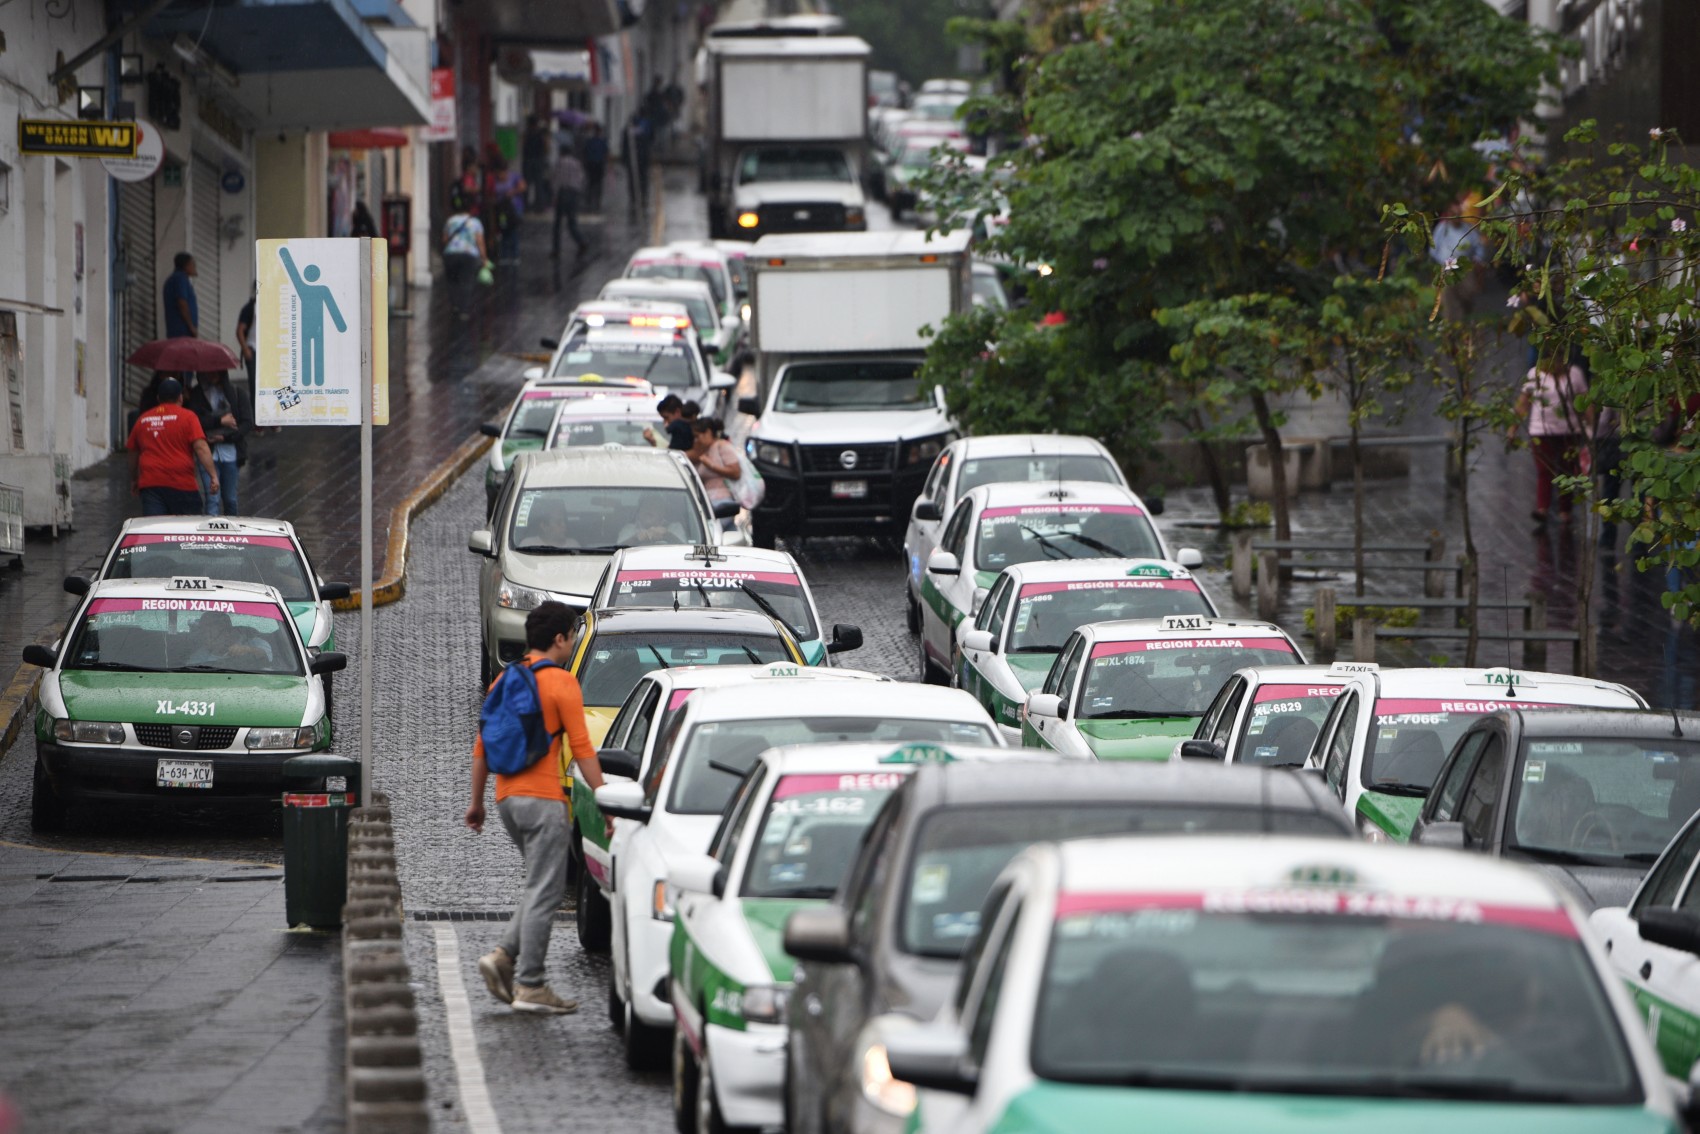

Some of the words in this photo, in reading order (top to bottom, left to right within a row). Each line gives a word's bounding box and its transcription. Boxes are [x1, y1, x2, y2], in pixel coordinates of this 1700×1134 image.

[26, 126, 89, 136] WESTERN
[45, 136, 89, 145] UNION
[163, 534, 206, 543] REGIÓN
[208, 535, 249, 544] XALAPA
[120, 546, 147, 555] XL-8108
[694, 545, 718, 556] TAXI
[662, 570, 707, 579] REGIÓN
[710, 571, 756, 580] XALAPA
[1138, 568, 1161, 576] TAXI
[174, 579, 207, 589] TAXI
[621, 580, 651, 588] XL-8222
[1067, 580, 1114, 590] REGIÓN
[1117, 581, 1164, 590] XALAPA
[142, 599, 187, 610] REGION
[190, 600, 236, 613] XALAPA
[103, 613, 136, 624] XL-4331
[1167, 618, 1200, 629] TAXI
[1146, 640, 1193, 650] REGION
[1195, 639, 1243, 649] XALAPA
[1108, 656, 1146, 666] XL-1874
[770, 668, 798, 677] TAXI
[1484, 673, 1520, 685] TAXI
[1307, 688, 1342, 697] REG
[155, 700, 216, 717] XL-4331
[1254, 701, 1302, 716] XL-6829
[1376, 714, 1440, 726] XL-7066
[903, 747, 946, 762] TAXI
[159, 766, 210, 780] A-634-XCV
[839, 774, 903, 790] REGI
